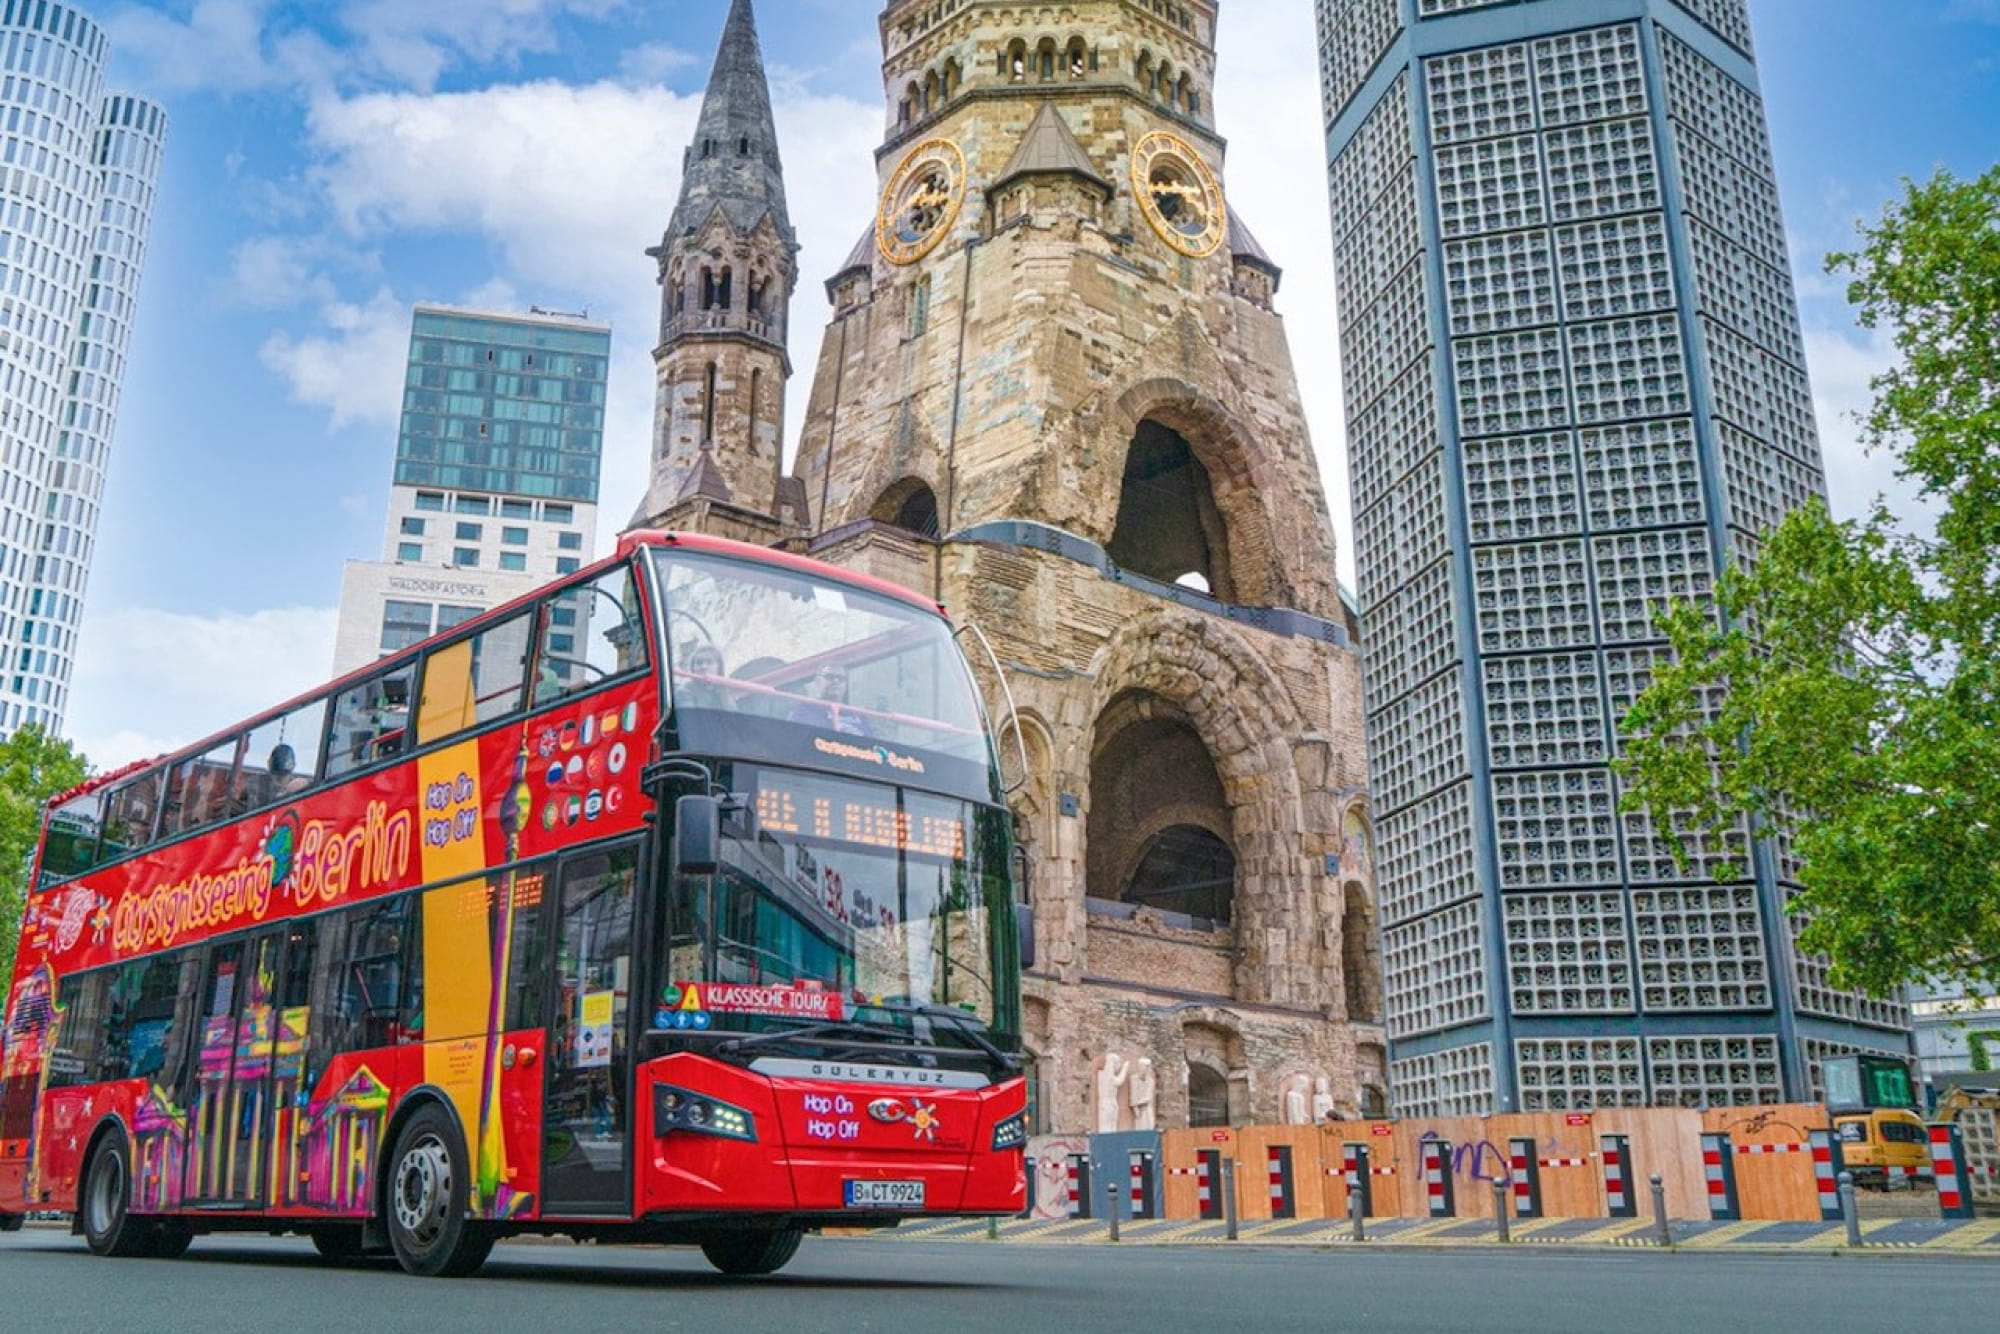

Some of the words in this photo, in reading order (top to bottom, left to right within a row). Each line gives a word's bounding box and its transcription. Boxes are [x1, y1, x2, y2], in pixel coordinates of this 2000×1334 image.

[389, 577, 440, 592] WALDORF
[425, 781, 452, 811] Hop
[453, 772, 473, 804] On
[425, 817, 452, 848] Hop
[453, 806, 477, 842] Off
[295, 799, 412, 907] Berlin
[707, 985, 785, 1009] KLASSISCHE
[804, 1094, 832, 1115] Hop
[835, 1095, 854, 1114] On
[808, 1119, 836, 1141] Hop
[838, 1120, 860, 1139] Off
